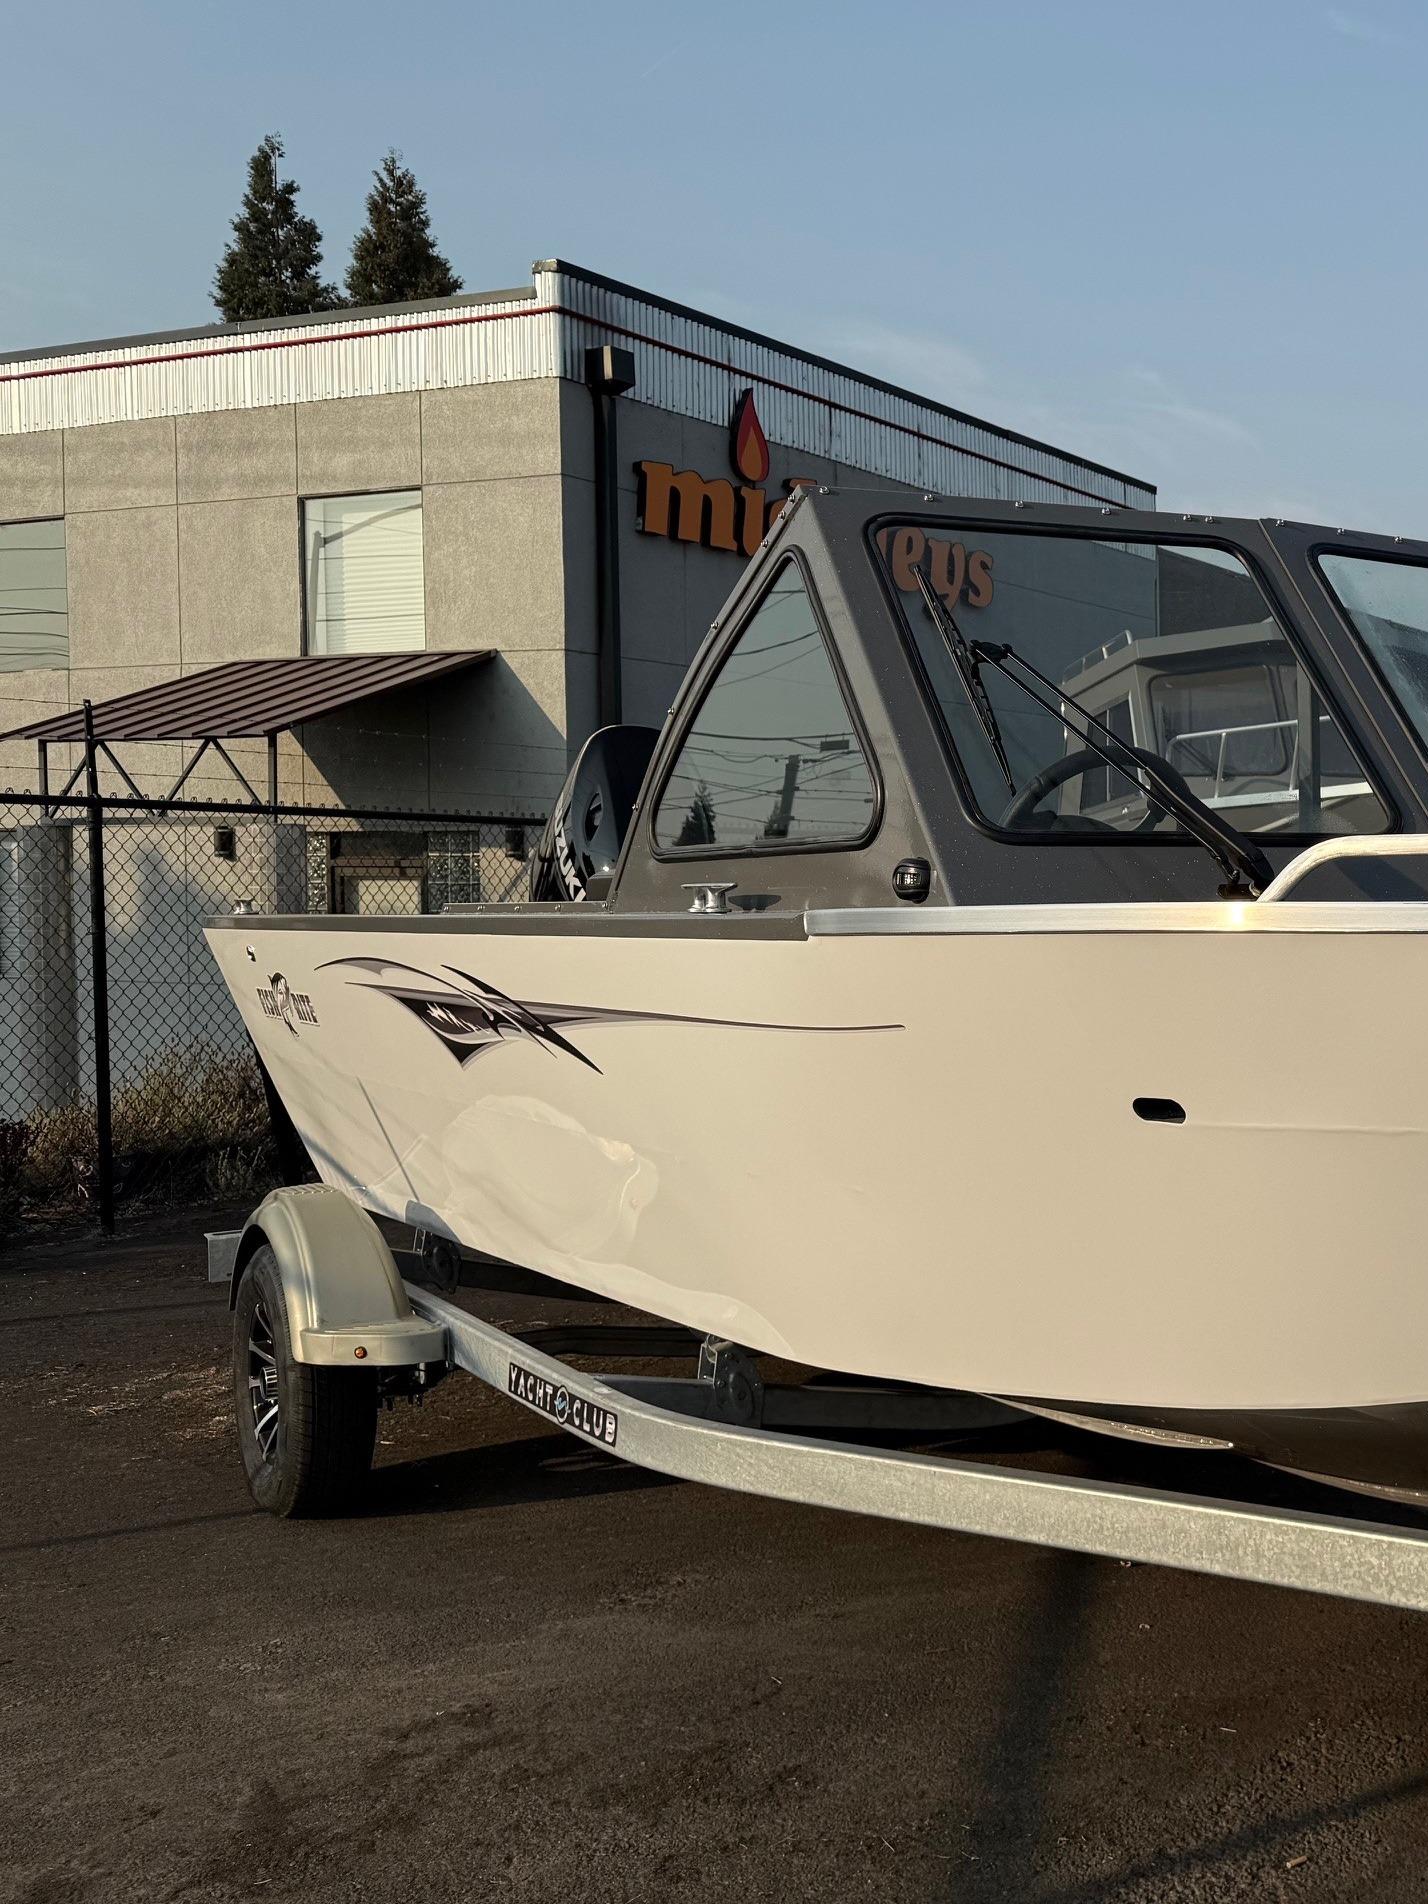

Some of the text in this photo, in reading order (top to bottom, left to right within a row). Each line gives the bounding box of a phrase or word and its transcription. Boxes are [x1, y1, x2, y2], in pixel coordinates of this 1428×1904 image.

[637, 460, 994, 610] mieys
[510, 1364, 616, 1443] YACHT CLUB
